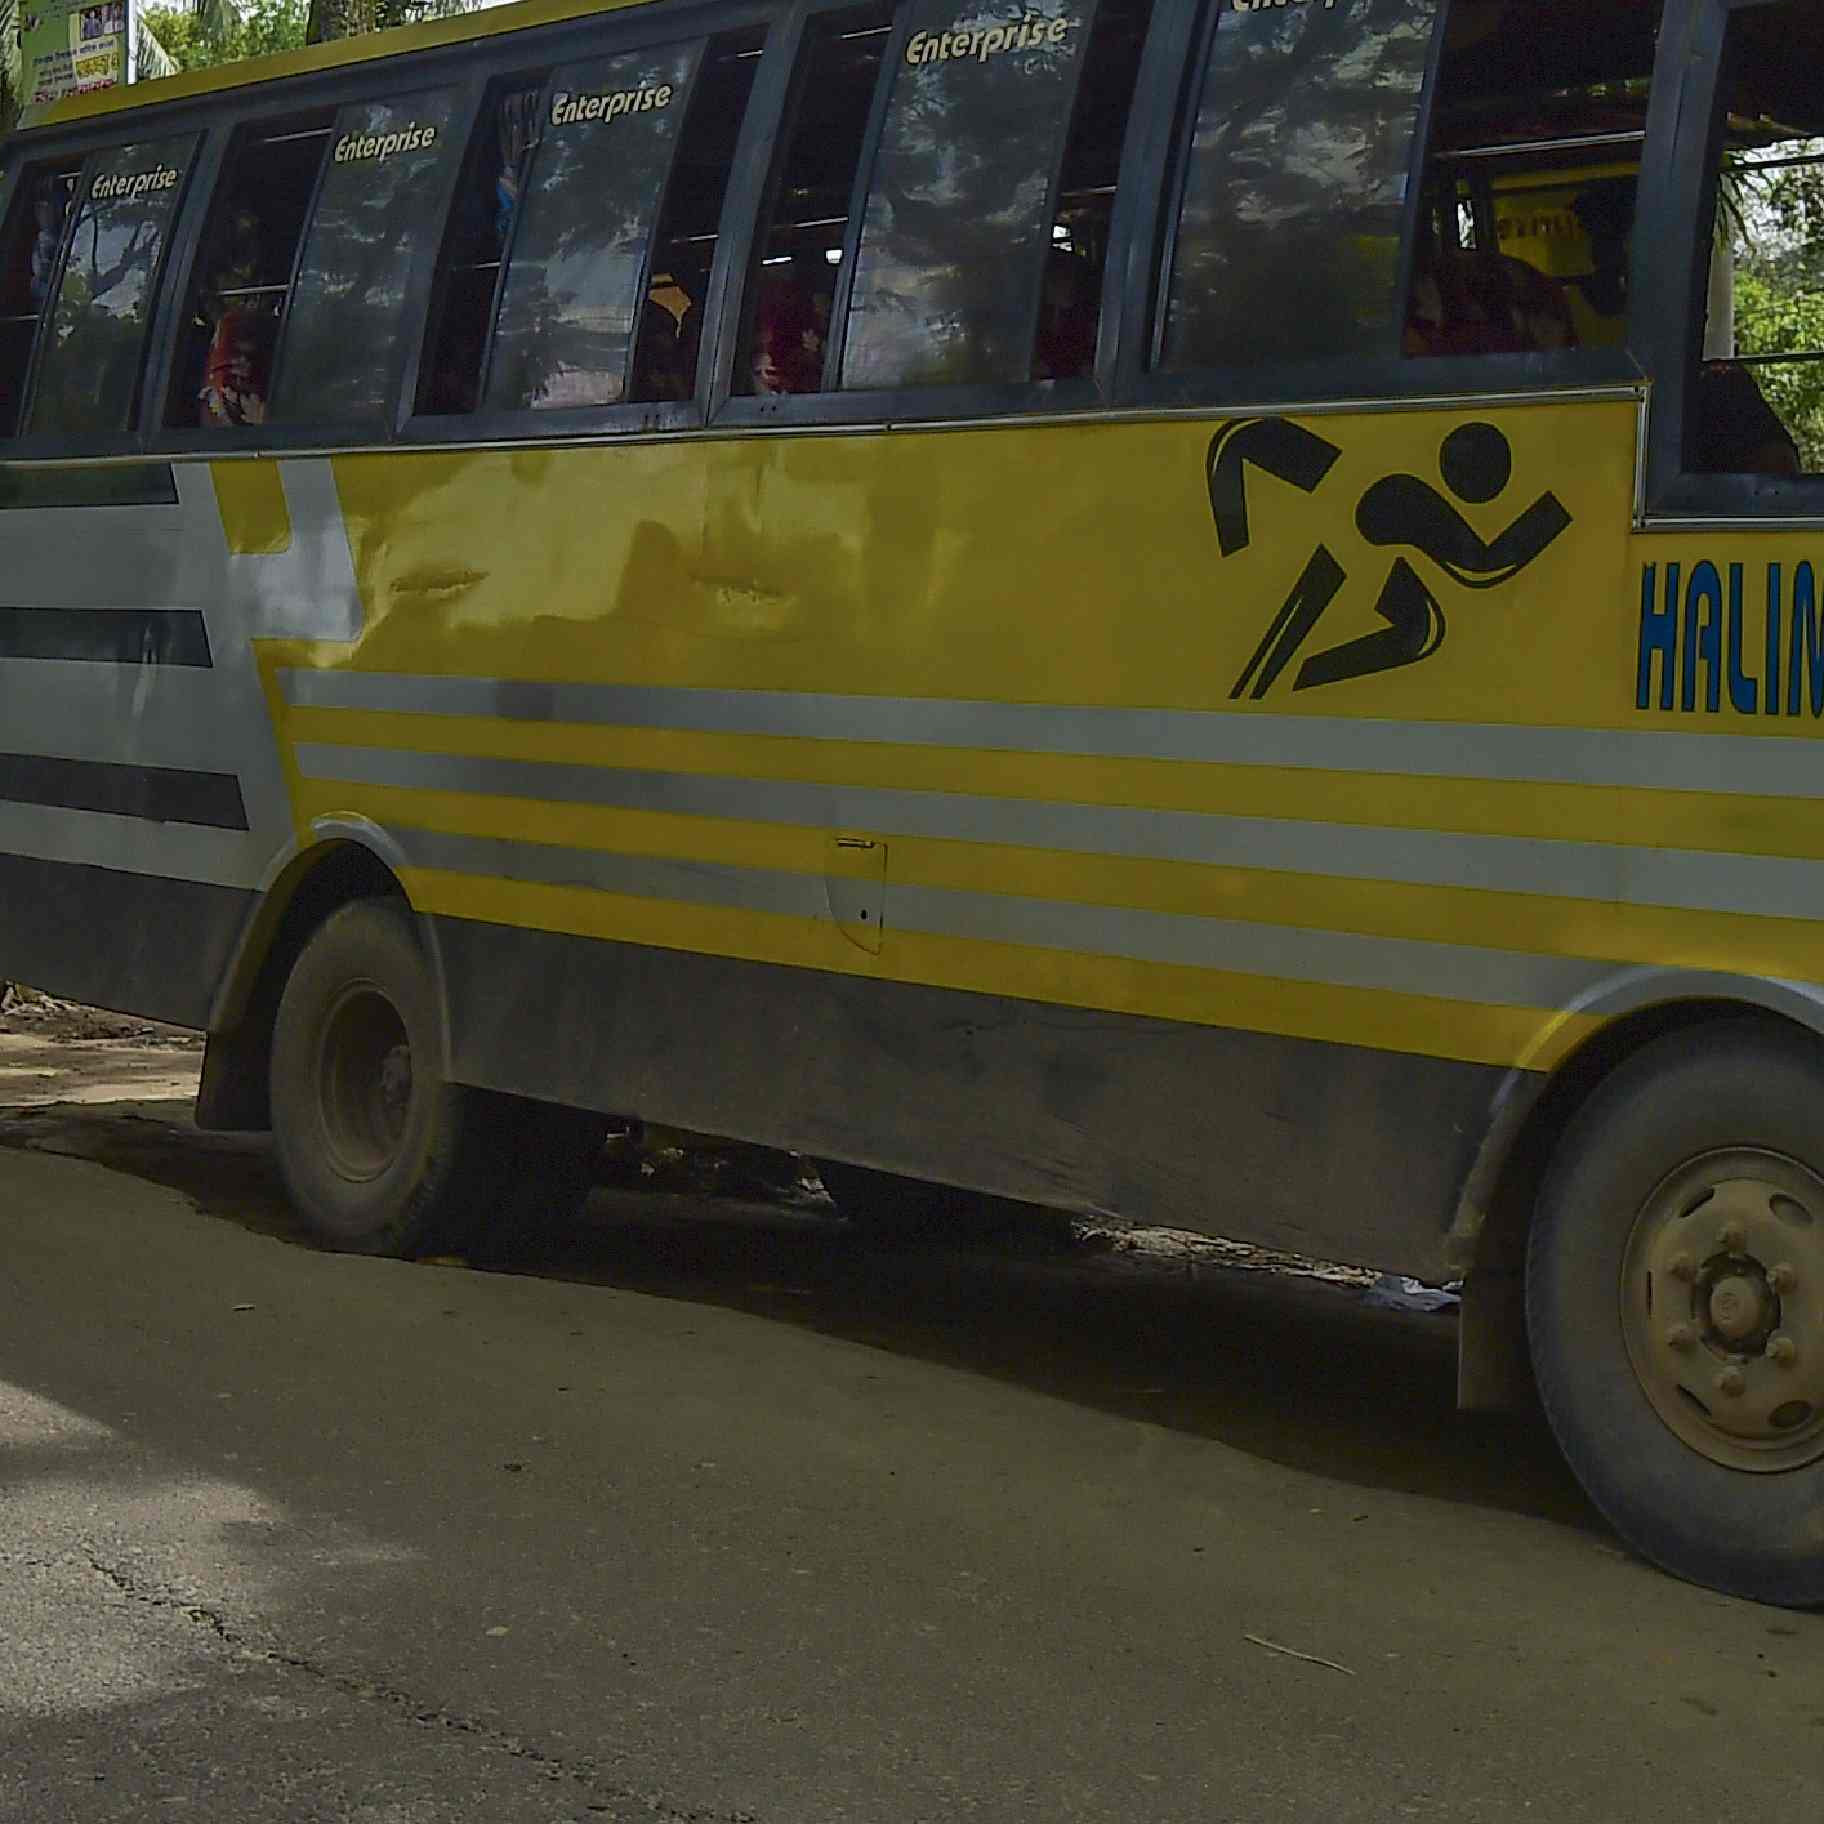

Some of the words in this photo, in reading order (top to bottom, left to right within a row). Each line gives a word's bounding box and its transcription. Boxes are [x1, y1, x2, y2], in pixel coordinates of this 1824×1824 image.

[905, 11, 1072, 67] Enterprise
[551, 80, 672, 127] Enterprise
[333, 121, 436, 164] Enterprise
[90, 166, 178, 200] Enterprise
